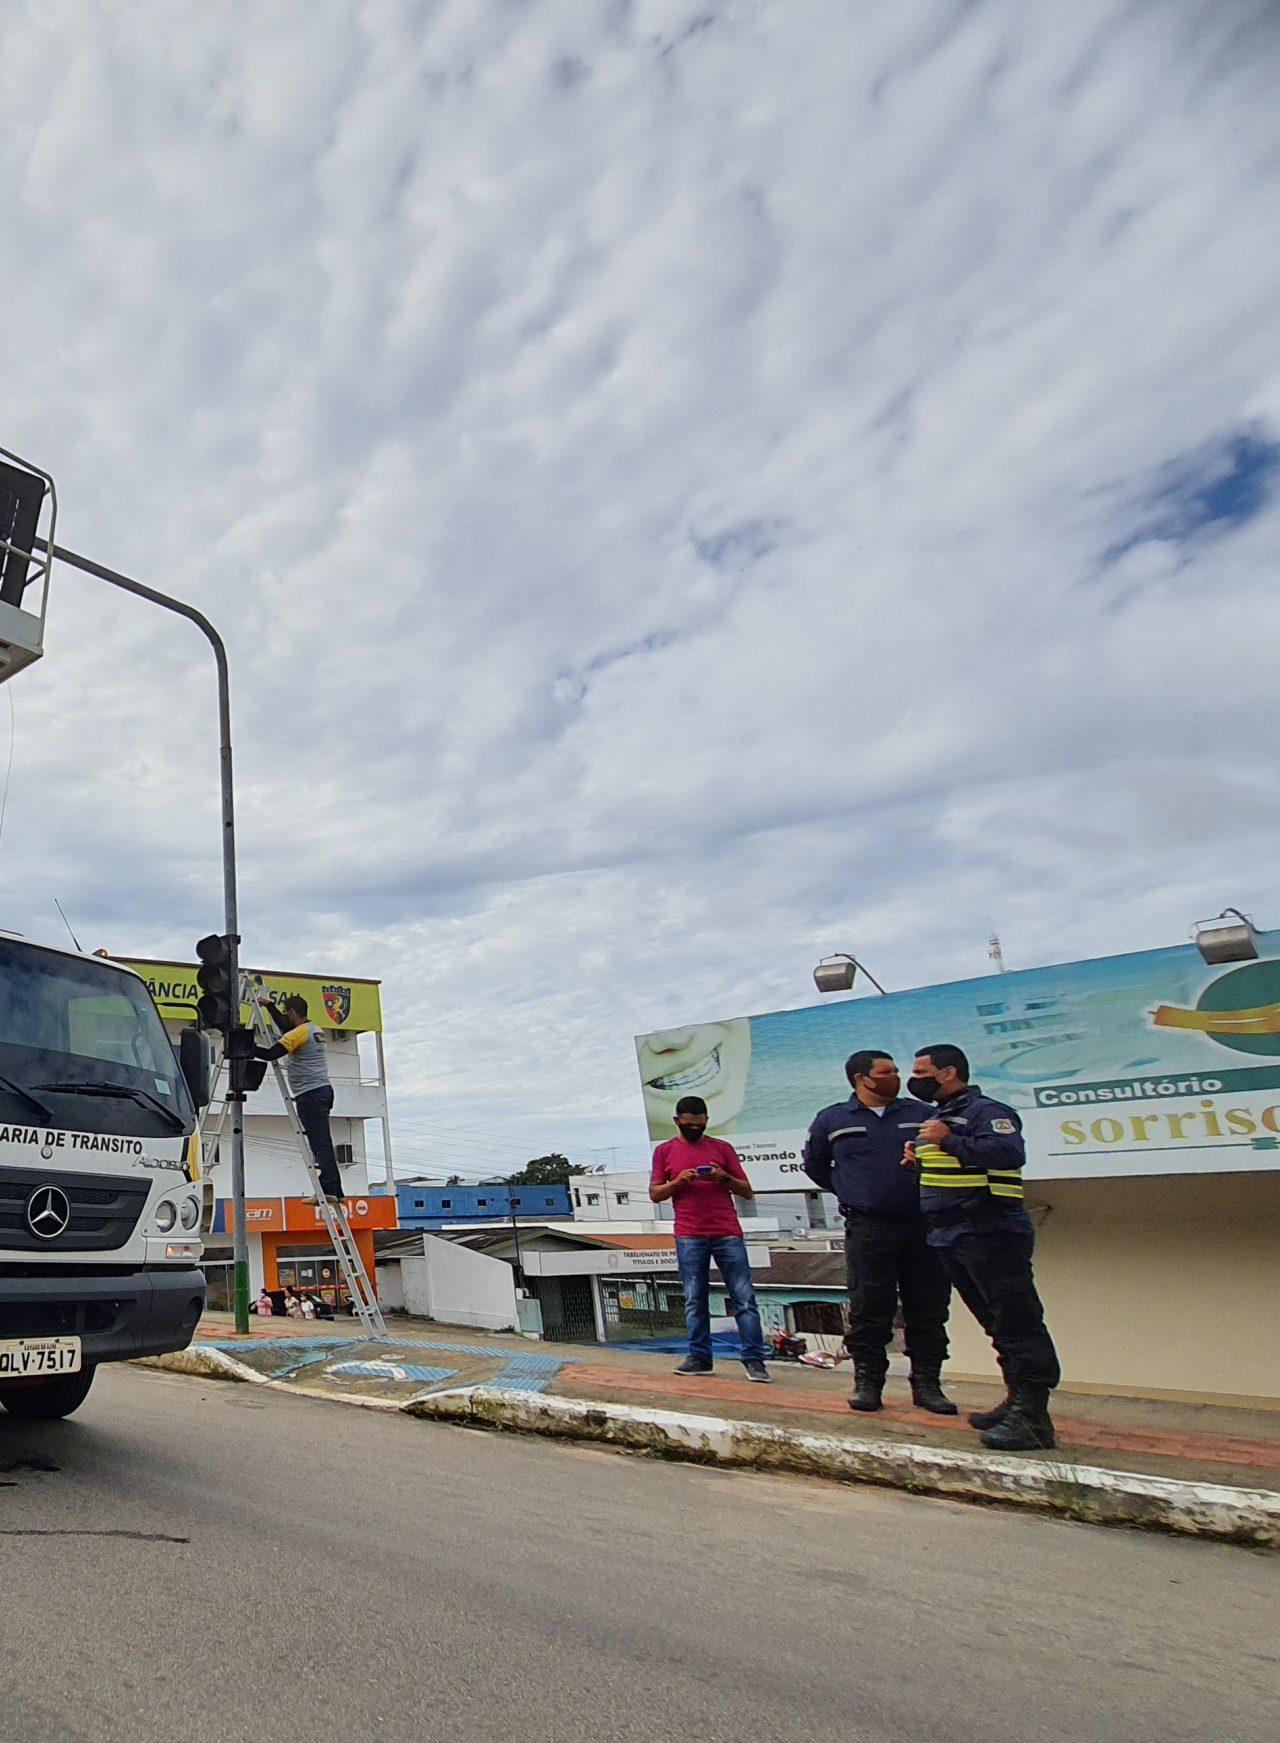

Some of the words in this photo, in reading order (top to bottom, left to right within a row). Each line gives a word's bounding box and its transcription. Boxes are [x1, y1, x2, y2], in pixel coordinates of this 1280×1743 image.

[1038, 1076, 1223, 1105] Consultório
[44, 1131, 66, 1148] DE
[737, 1150, 797, 1163] Osvando
